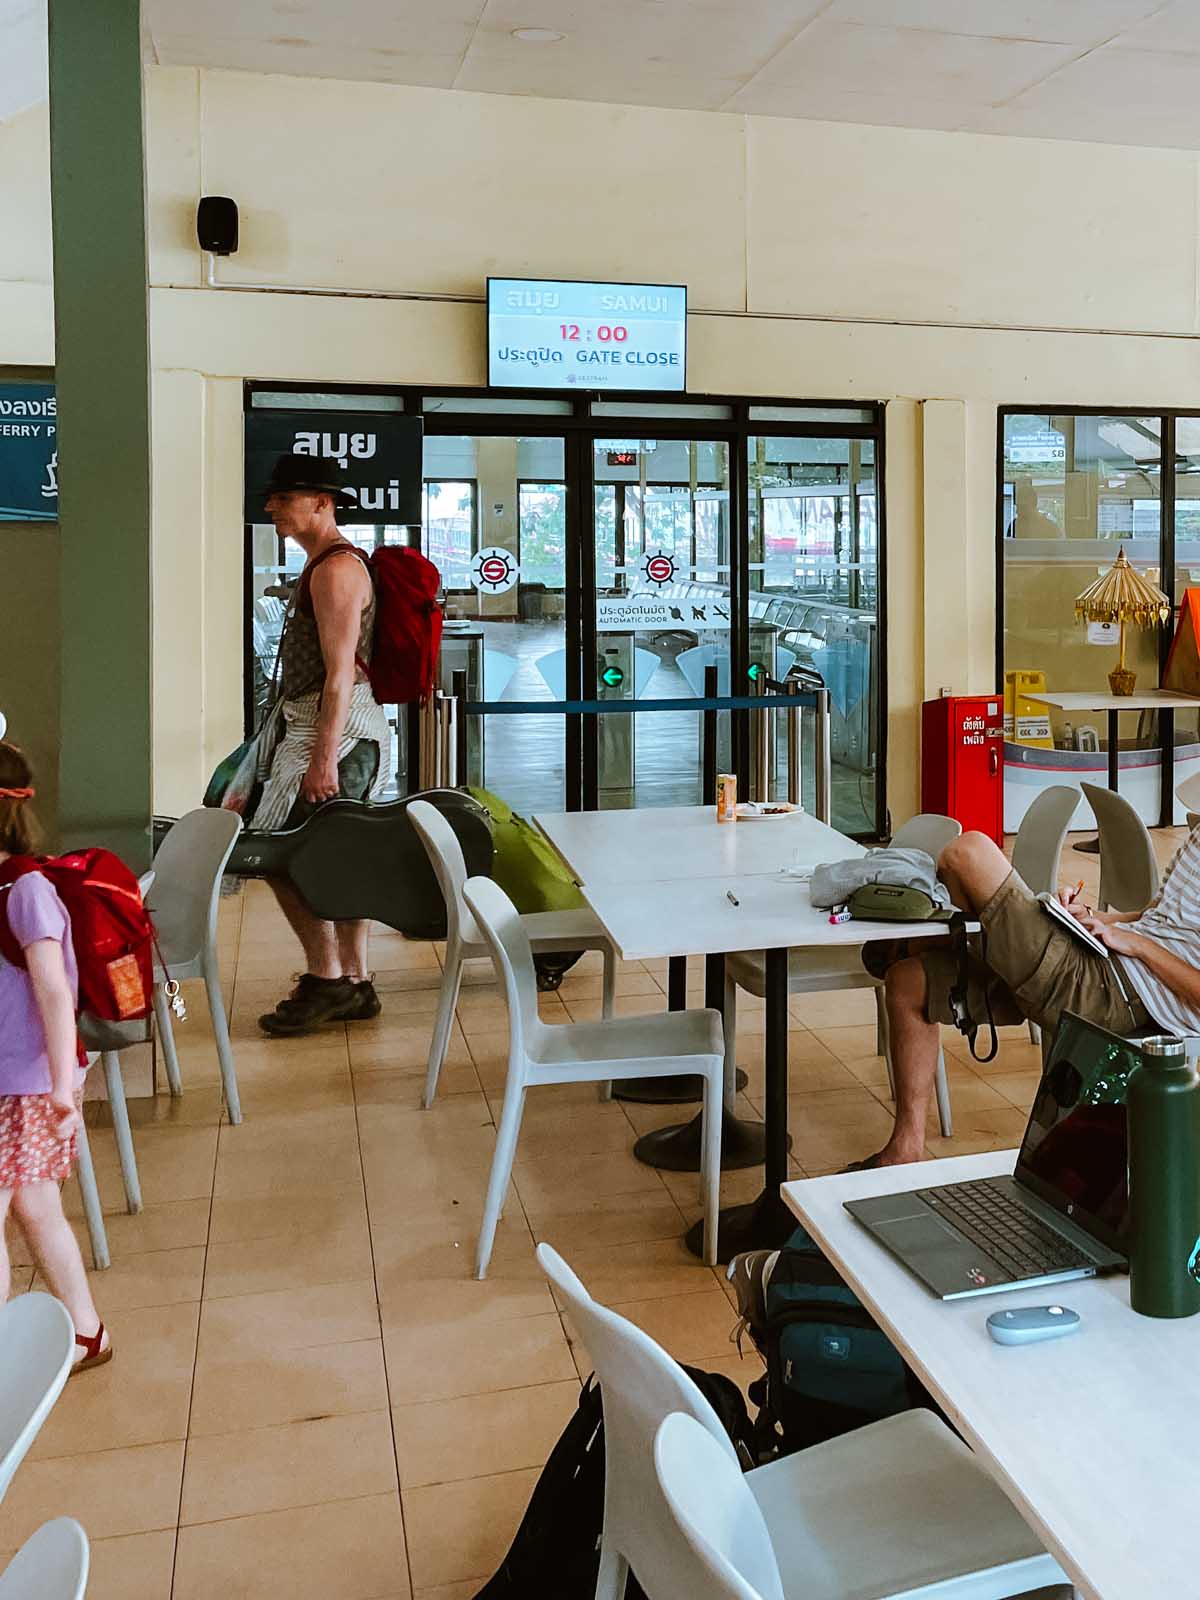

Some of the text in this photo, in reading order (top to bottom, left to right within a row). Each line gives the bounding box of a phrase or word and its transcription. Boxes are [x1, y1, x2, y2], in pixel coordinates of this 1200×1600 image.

[601, 295, 668, 312] SAMUI
[498, 347, 680, 367] ประตูปิด GATE CLOSE
[292, 432, 377, 469] สมุย
